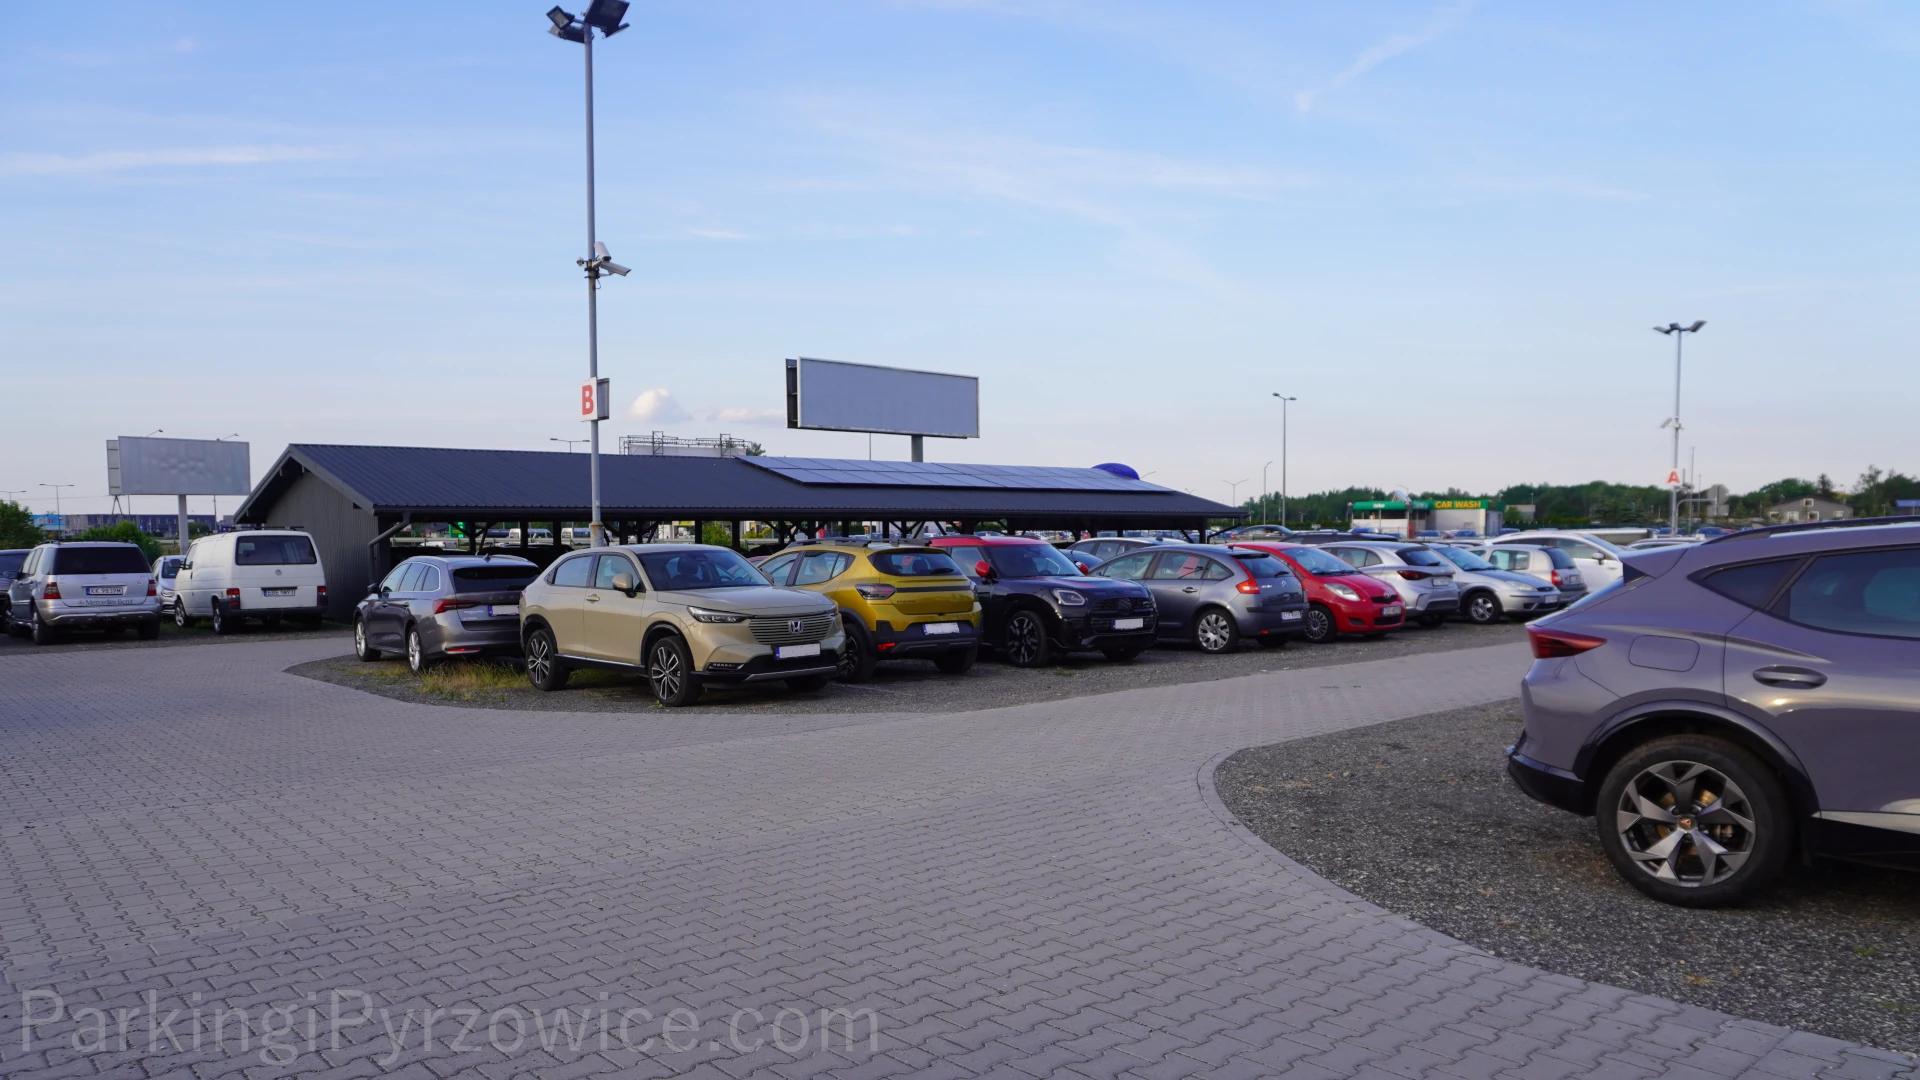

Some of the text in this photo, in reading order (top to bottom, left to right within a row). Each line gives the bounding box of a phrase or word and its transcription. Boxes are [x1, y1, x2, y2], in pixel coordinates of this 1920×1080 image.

[581, 384, 594, 415] B
[1667, 470, 1681, 483] A
[1435, 500, 1453, 509] CAR
[1455, 500, 1480, 509] WASH
